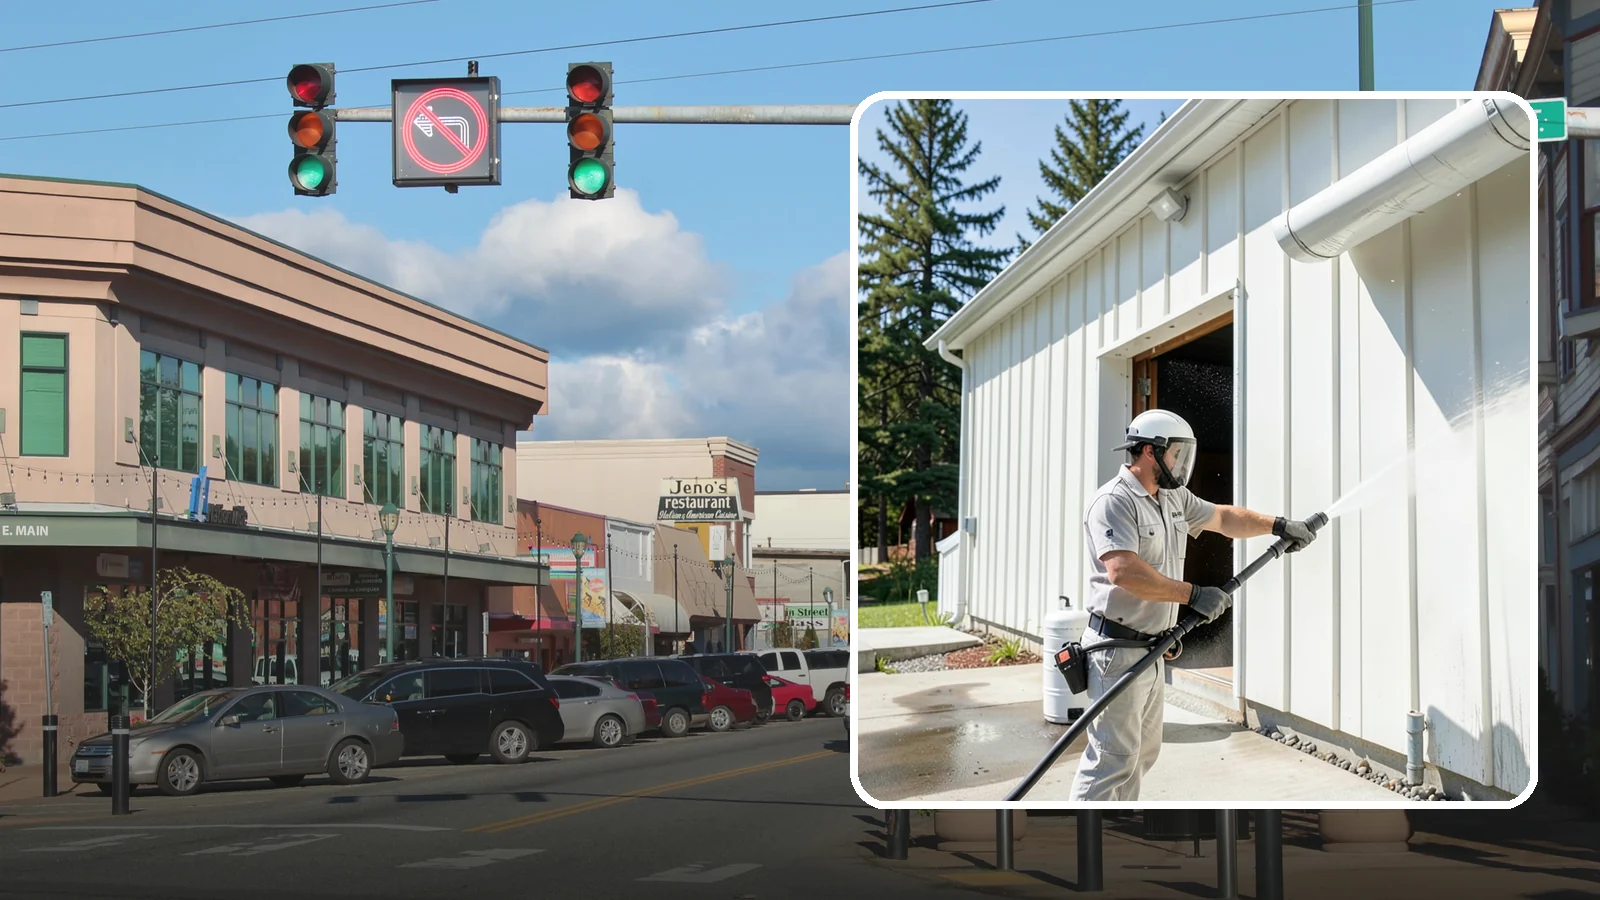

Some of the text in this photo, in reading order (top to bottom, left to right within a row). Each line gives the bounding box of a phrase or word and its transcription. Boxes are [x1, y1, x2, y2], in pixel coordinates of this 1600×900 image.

[669, 479, 728, 495] Jeno's
[664, 496, 731, 509] restaurant
[658, 510, 681, 520] Italian
[686, 509, 714, 520] American
[714, 509, 738, 520] Cuisine
[2, 525, 49, 536] E. MAIN
[797, 607, 828, 617] Street
[790, 619, 824, 627] lass
